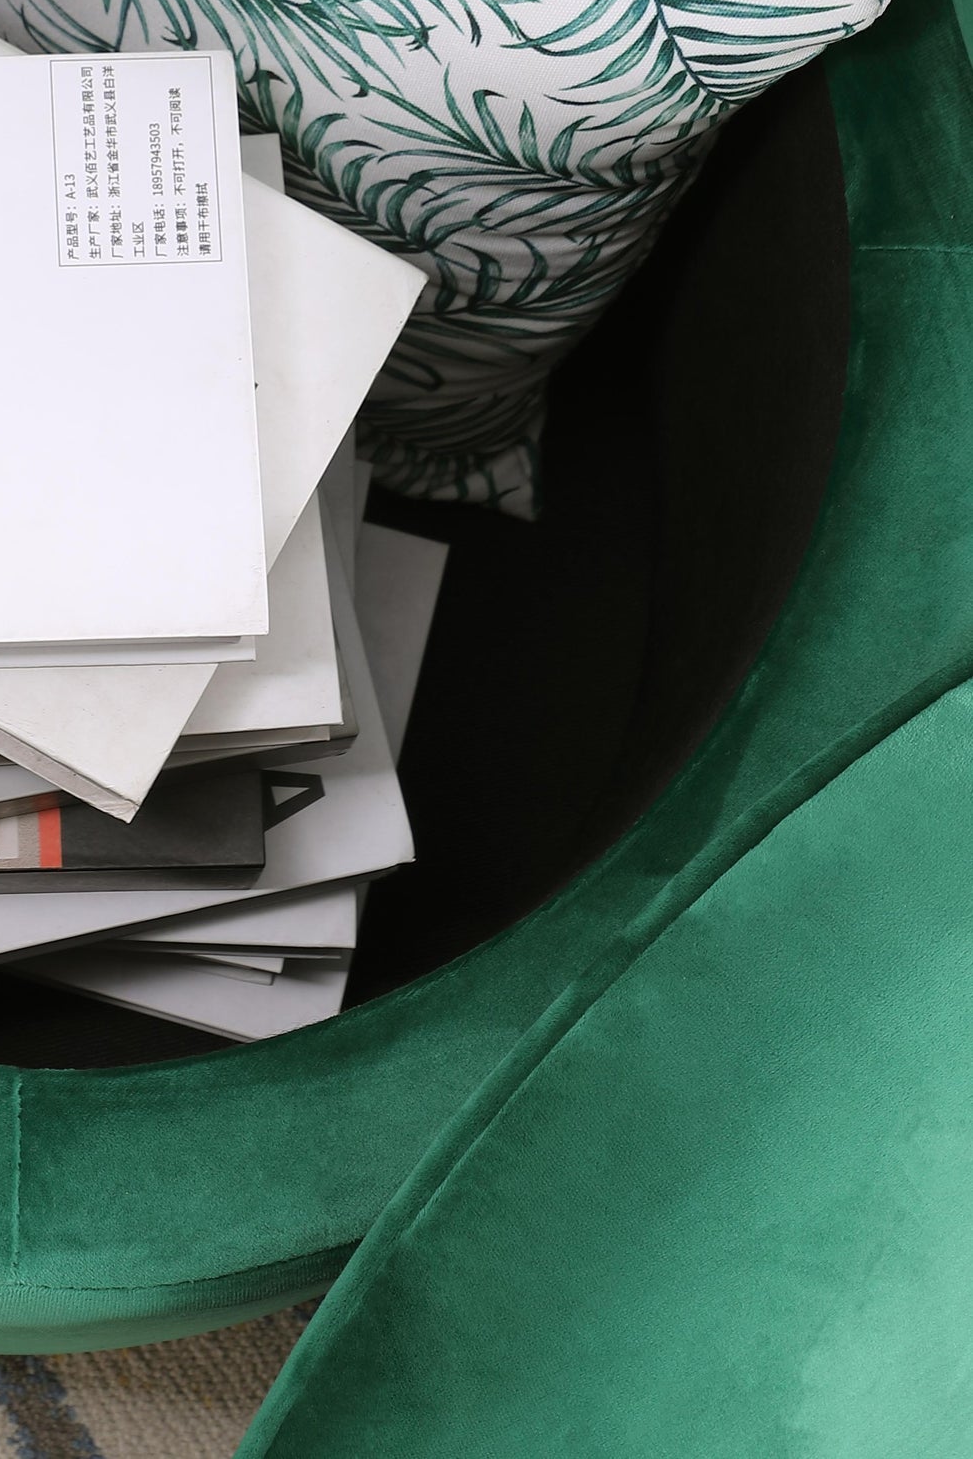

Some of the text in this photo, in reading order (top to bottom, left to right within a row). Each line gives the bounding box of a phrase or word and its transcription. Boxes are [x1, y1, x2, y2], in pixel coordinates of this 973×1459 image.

[132, 222, 145, 256] 工业区
[197, 184, 211, 254] 请用干布擦拭
